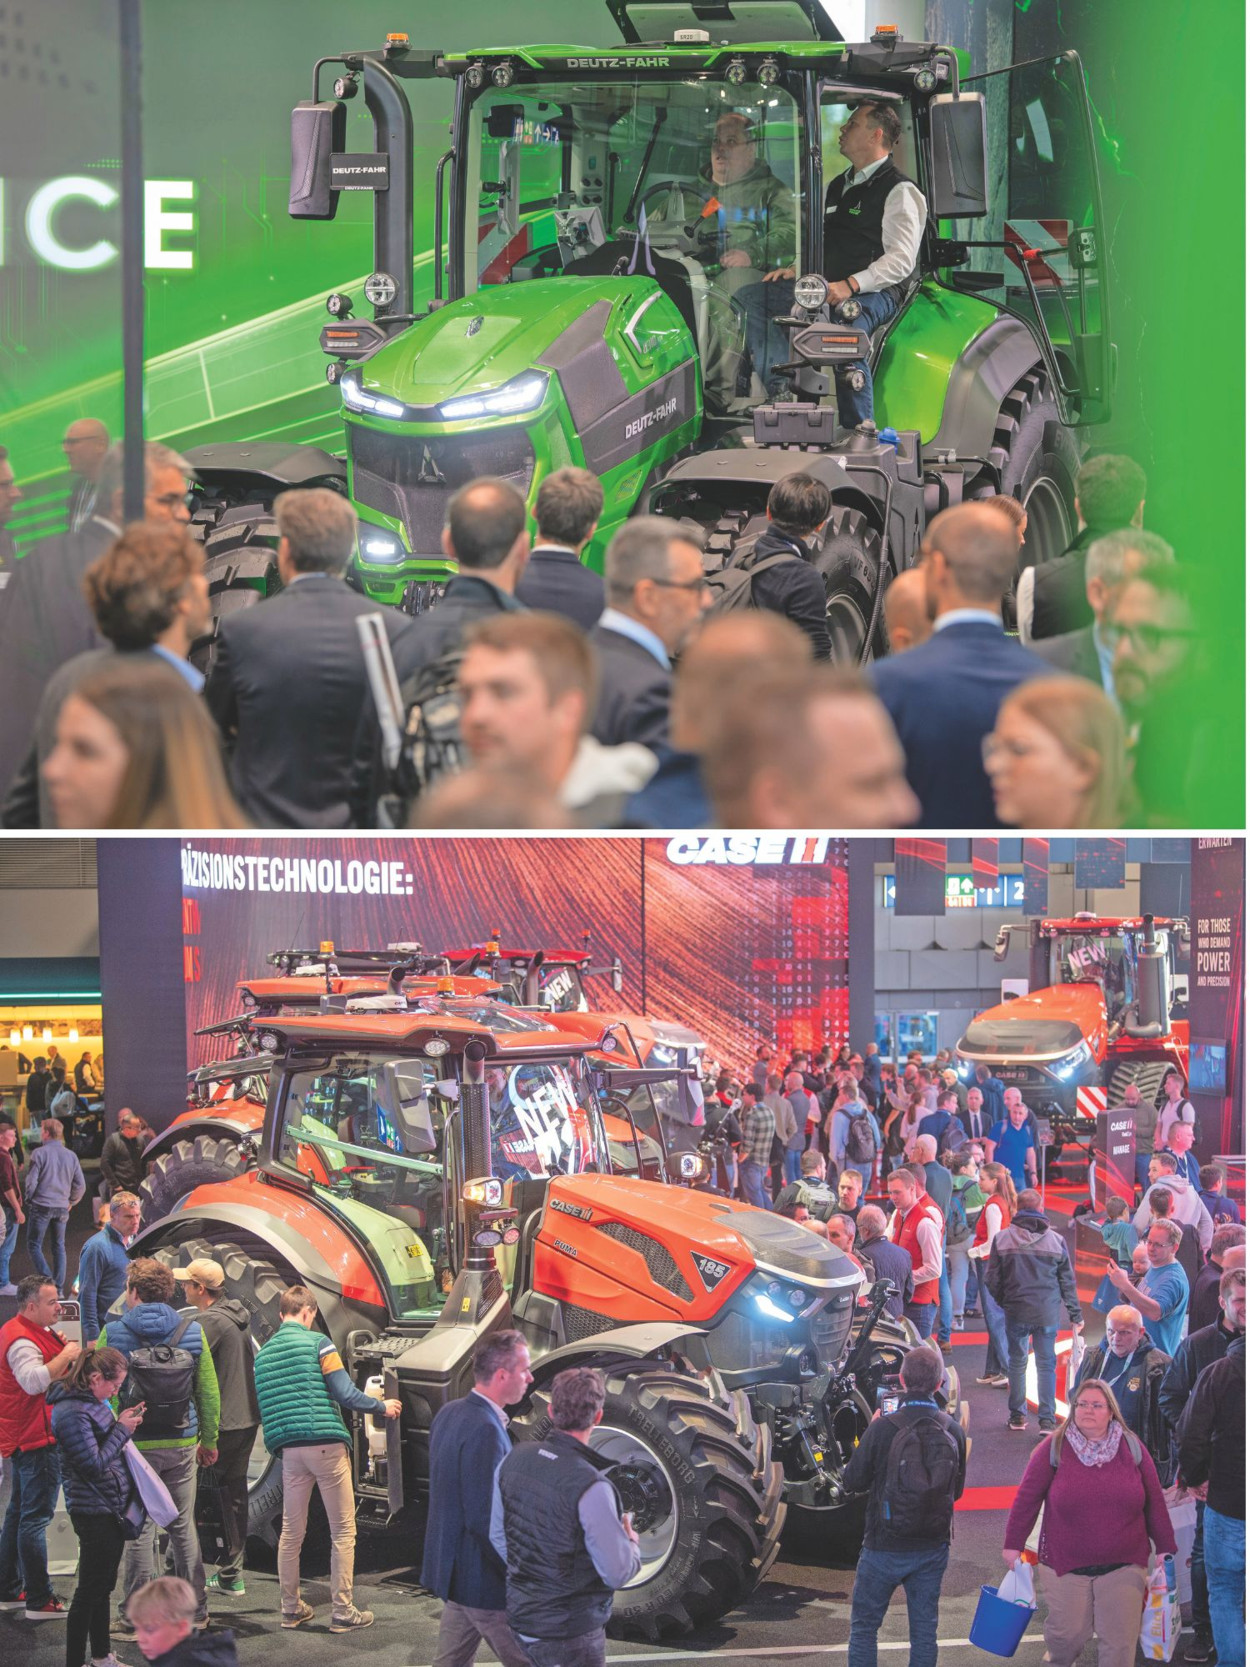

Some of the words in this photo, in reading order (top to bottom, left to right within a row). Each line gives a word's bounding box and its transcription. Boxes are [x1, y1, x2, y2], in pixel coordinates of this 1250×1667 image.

[566, 57, 670, 68] DEUTZ-FAHR
[332, 166, 387, 174] DEUTZ-FAHR
[0, 176, 193, 270] CE
[625, 397, 677, 440] DEUTZ-FAHR
[666, 837, 787, 865] CASE
[1197, 920, 1209, 934] FOR
[1210, 918, 1231, 933] THOSE
[1197, 938, 1209, 949] WHO
[1210, 937, 1231, 948] DEMAND
[1067, 940, 1106, 977] NEW
[1197, 952, 1231, 972] POWER
[1197, 976, 1206, 987] AND
[1206, 977, 1230, 987] PRECISION
[513, 1070, 579, 1145] NEW
[1110, 1121, 1127, 1131] CASE
[550, 1198, 582, 1216] CASE
[554, 1239, 578, 1256] PUMA
[699, 1259, 726, 1279] 185
[628, 1403, 696, 1485] TRELLEBORG
